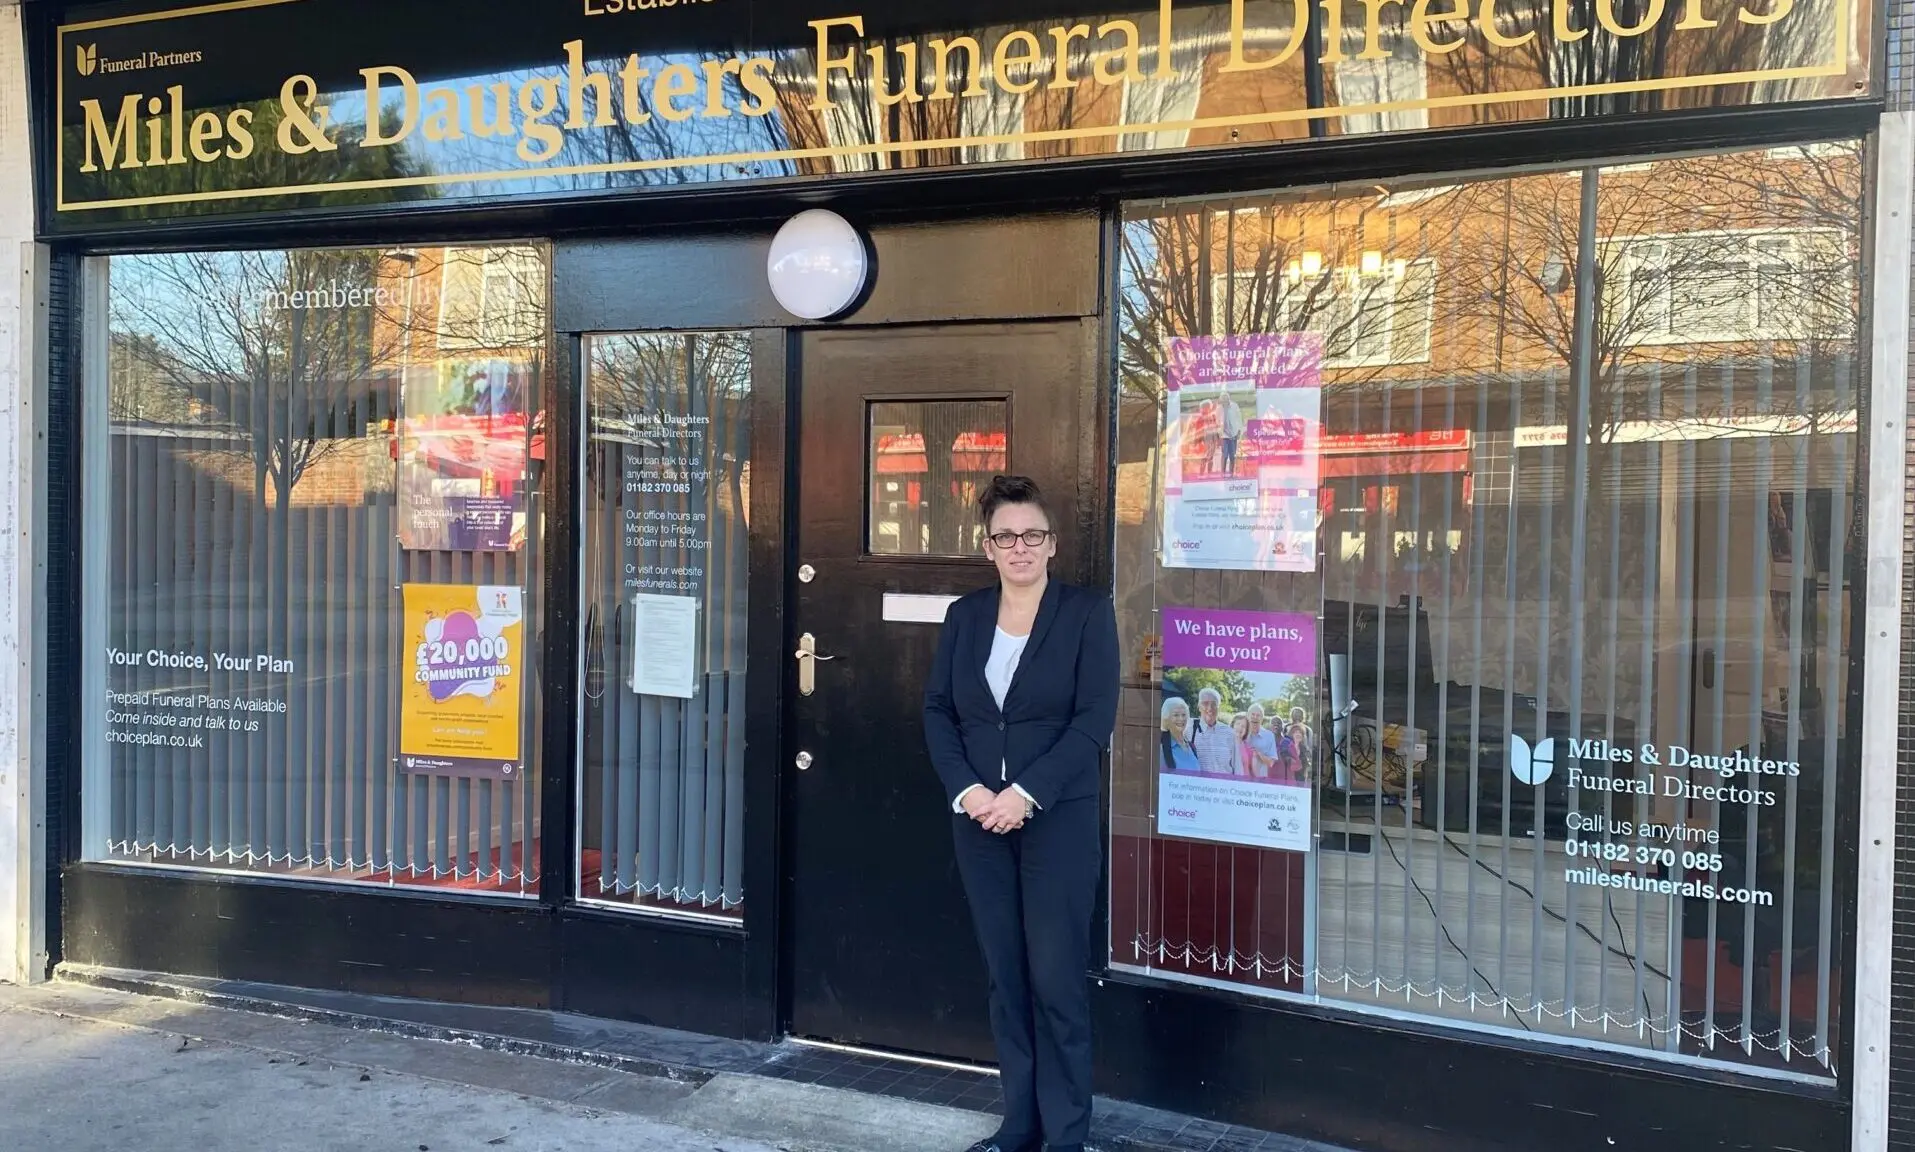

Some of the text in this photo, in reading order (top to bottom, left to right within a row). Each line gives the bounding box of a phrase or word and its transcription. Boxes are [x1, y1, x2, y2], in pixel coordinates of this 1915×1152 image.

[99, 50, 202, 74] Funeral Partners
[79, 84, 255, 174] Miles
[276, 73, 338, 156] &
[359, 39, 778, 163] Daughters
[807, 0, 1180, 111] Funeral
[627, 413, 710, 427] Miles & Daughters
[627, 427, 702, 438] Funeral Directors
[626, 455, 700, 466] You can talk to us
[626, 469, 712, 482] anytime, day or night
[626, 482, 691, 493] 01182 370 085
[1228, 483, 1251, 492] choice
[413, 494, 431, 505] The
[413, 506, 453, 519] personal
[626, 509, 706, 521] Our office hours are
[413, 518, 440, 529] touch
[625, 523, 696, 537] Monday to Friday
[625, 536, 712, 550] 9.00am until 5.00pm
[1172, 540, 1201, 549] choice
[625, 563, 703, 577] Or visit our website
[624, 578, 698, 590] milesfunerals.com
[1174, 619, 1304, 644] We have plans,
[415, 635, 509, 666] £20,000
[1204, 642, 1272, 663] do you?
[105, 647, 294, 674] Your Choice, Your Plan
[415, 663, 511, 683] COMMUNITY FUND
[105, 690, 287, 713] Prepaid Funeral Plans Available
[105, 710, 259, 732] Come inside and talk to us
[105, 729, 204, 749] choiceplan.co.uk
[1567, 738, 1801, 778] Miles & Daughters
[1180, 782, 1218, 794] information
[1229, 787, 1252, 797] Choice
[1254, 790, 1279, 800] Funeral
[1566, 767, 1776, 807] Funeral Directors
[1193, 794, 1211, 803] today
[1235, 799, 1297, 812] choiceplan.co.uk
[1167, 807, 1196, 819] choice
[1565, 811, 1720, 845] Call us anytime
[1564, 838, 1724, 873] 01182 370 085
[1564, 866, 1774, 907] milesfunerals.com
